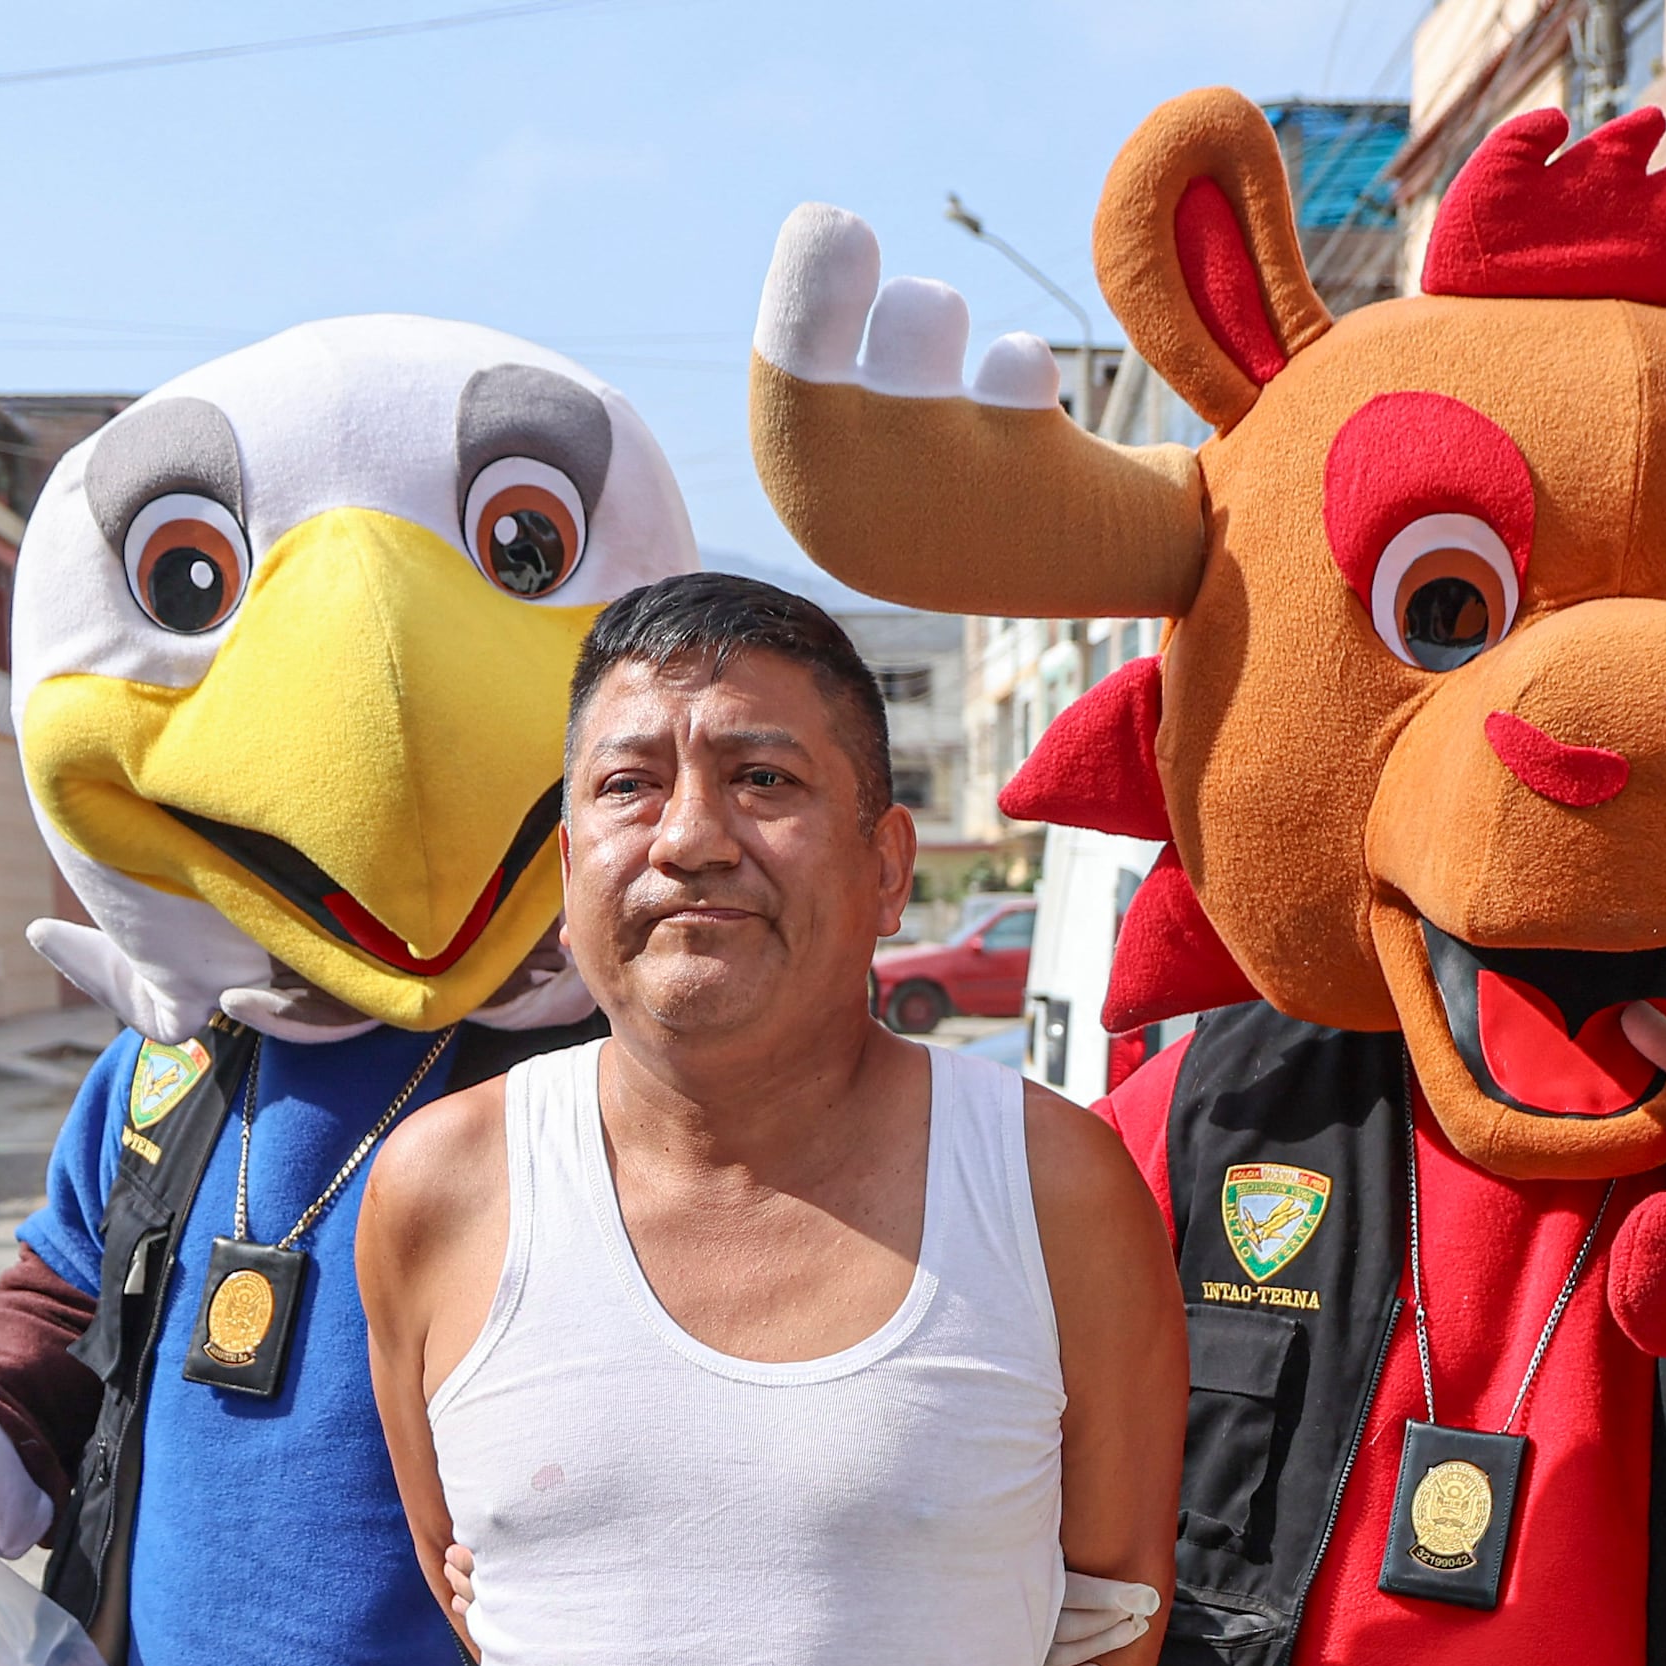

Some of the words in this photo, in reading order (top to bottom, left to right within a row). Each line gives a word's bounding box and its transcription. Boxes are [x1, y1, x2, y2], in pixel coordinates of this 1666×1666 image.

[1227, 1203, 1251, 1257] INTAO
[1270, 1214, 1318, 1264] TERNA
[1201, 1281, 1321, 1310] INTAO-TERNA
[1416, 1548, 1470, 1568] 32199042
